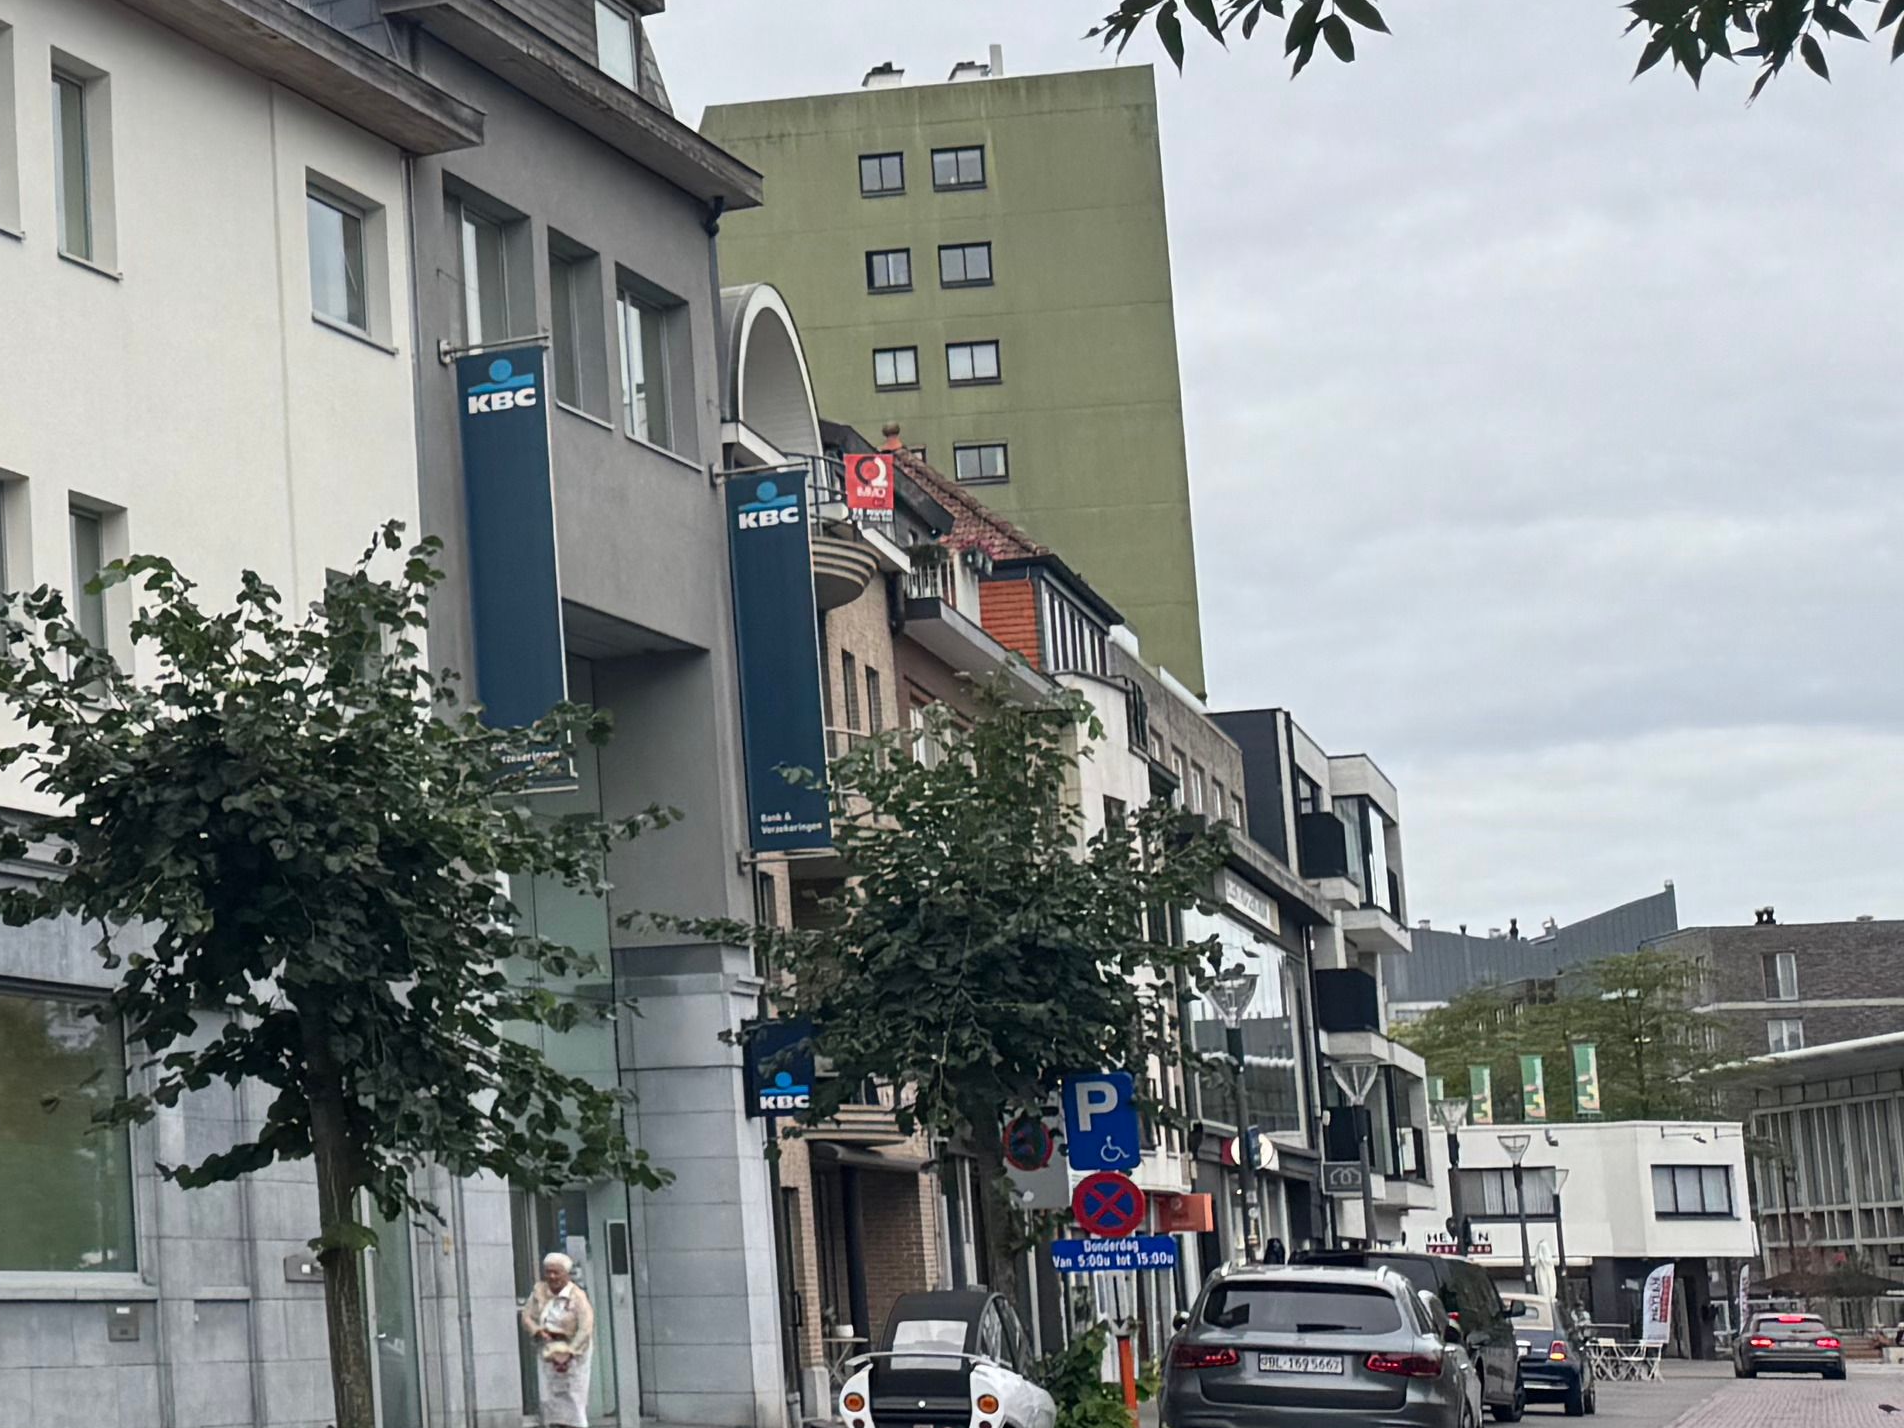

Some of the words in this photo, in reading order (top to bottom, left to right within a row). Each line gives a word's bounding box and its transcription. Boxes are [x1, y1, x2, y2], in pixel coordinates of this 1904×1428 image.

[468, 386, 536, 414] KBC
[738, 506, 799, 529] KBC
[759, 1094, 810, 1110] KBC
[1075, 1081, 1119, 1132] P
[1083, 1239, 1139, 1253] Donderdag
[1052, 1255, 1072, 1268] Van
[1077, 1254, 1110, 1267] 5:00u
[1116, 1253, 1131, 1266] tot
[1136, 1252, 1174, 1265] 15:00u
